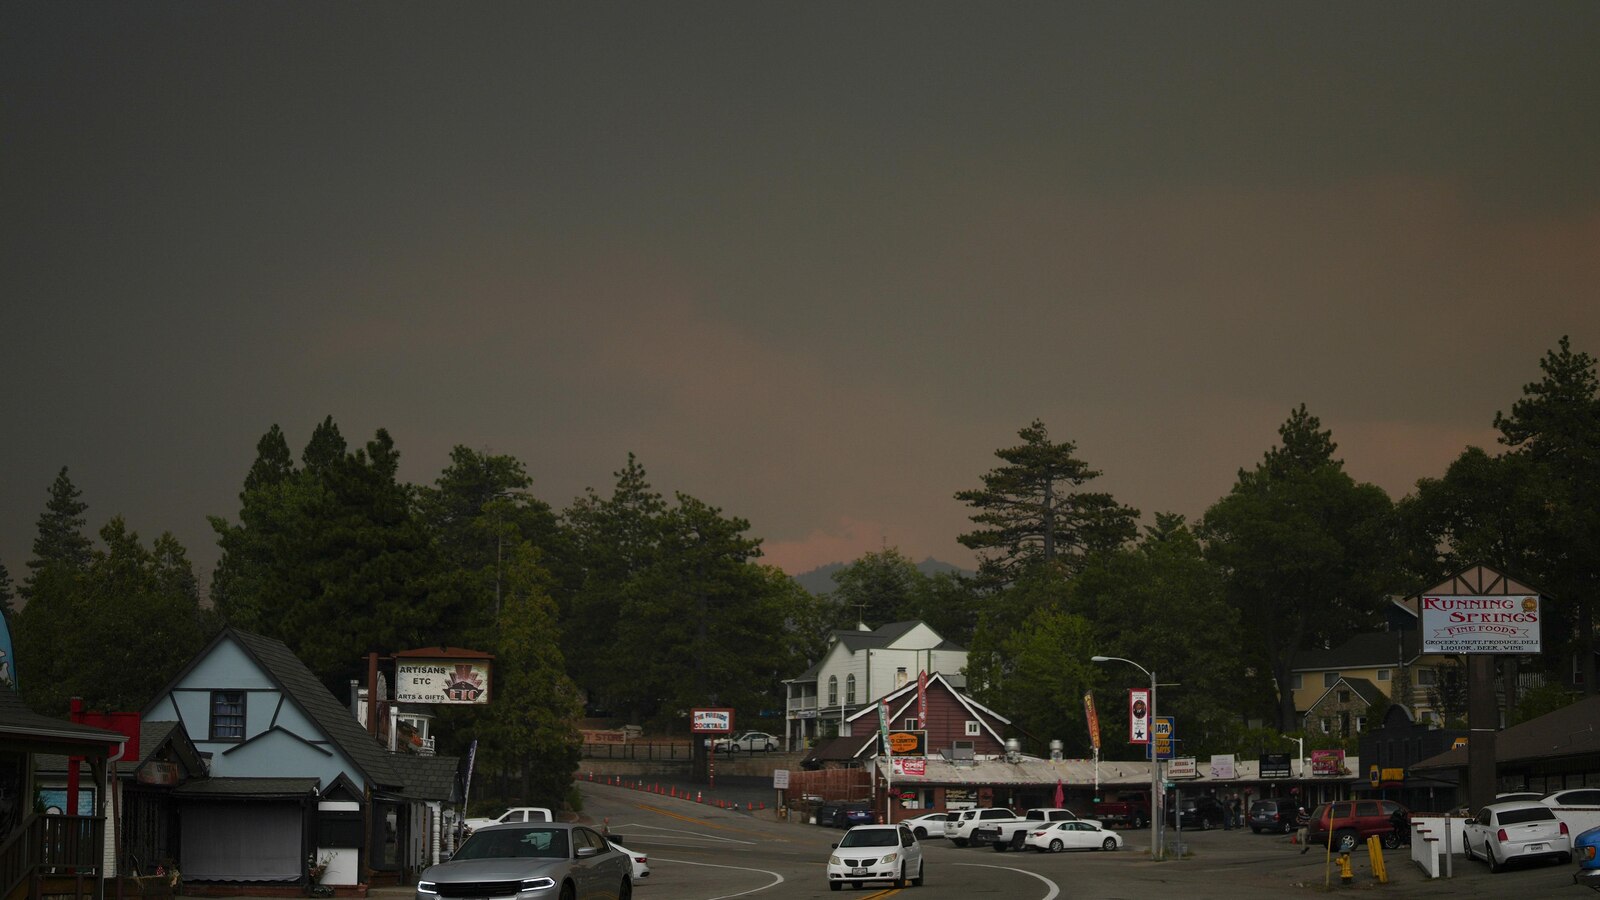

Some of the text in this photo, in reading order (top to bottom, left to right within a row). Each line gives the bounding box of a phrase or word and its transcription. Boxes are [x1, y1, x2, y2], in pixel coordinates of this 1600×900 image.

[1422, 597, 1514, 612] RUNNING
[1449, 611, 1538, 623] SPRINGS
[1447, 625, 1517, 636] FINE FOODS
[400, 666, 446, 674] ARTISANS
[449, 688, 479, 701] ETC
[695, 713, 704, 721] THE
